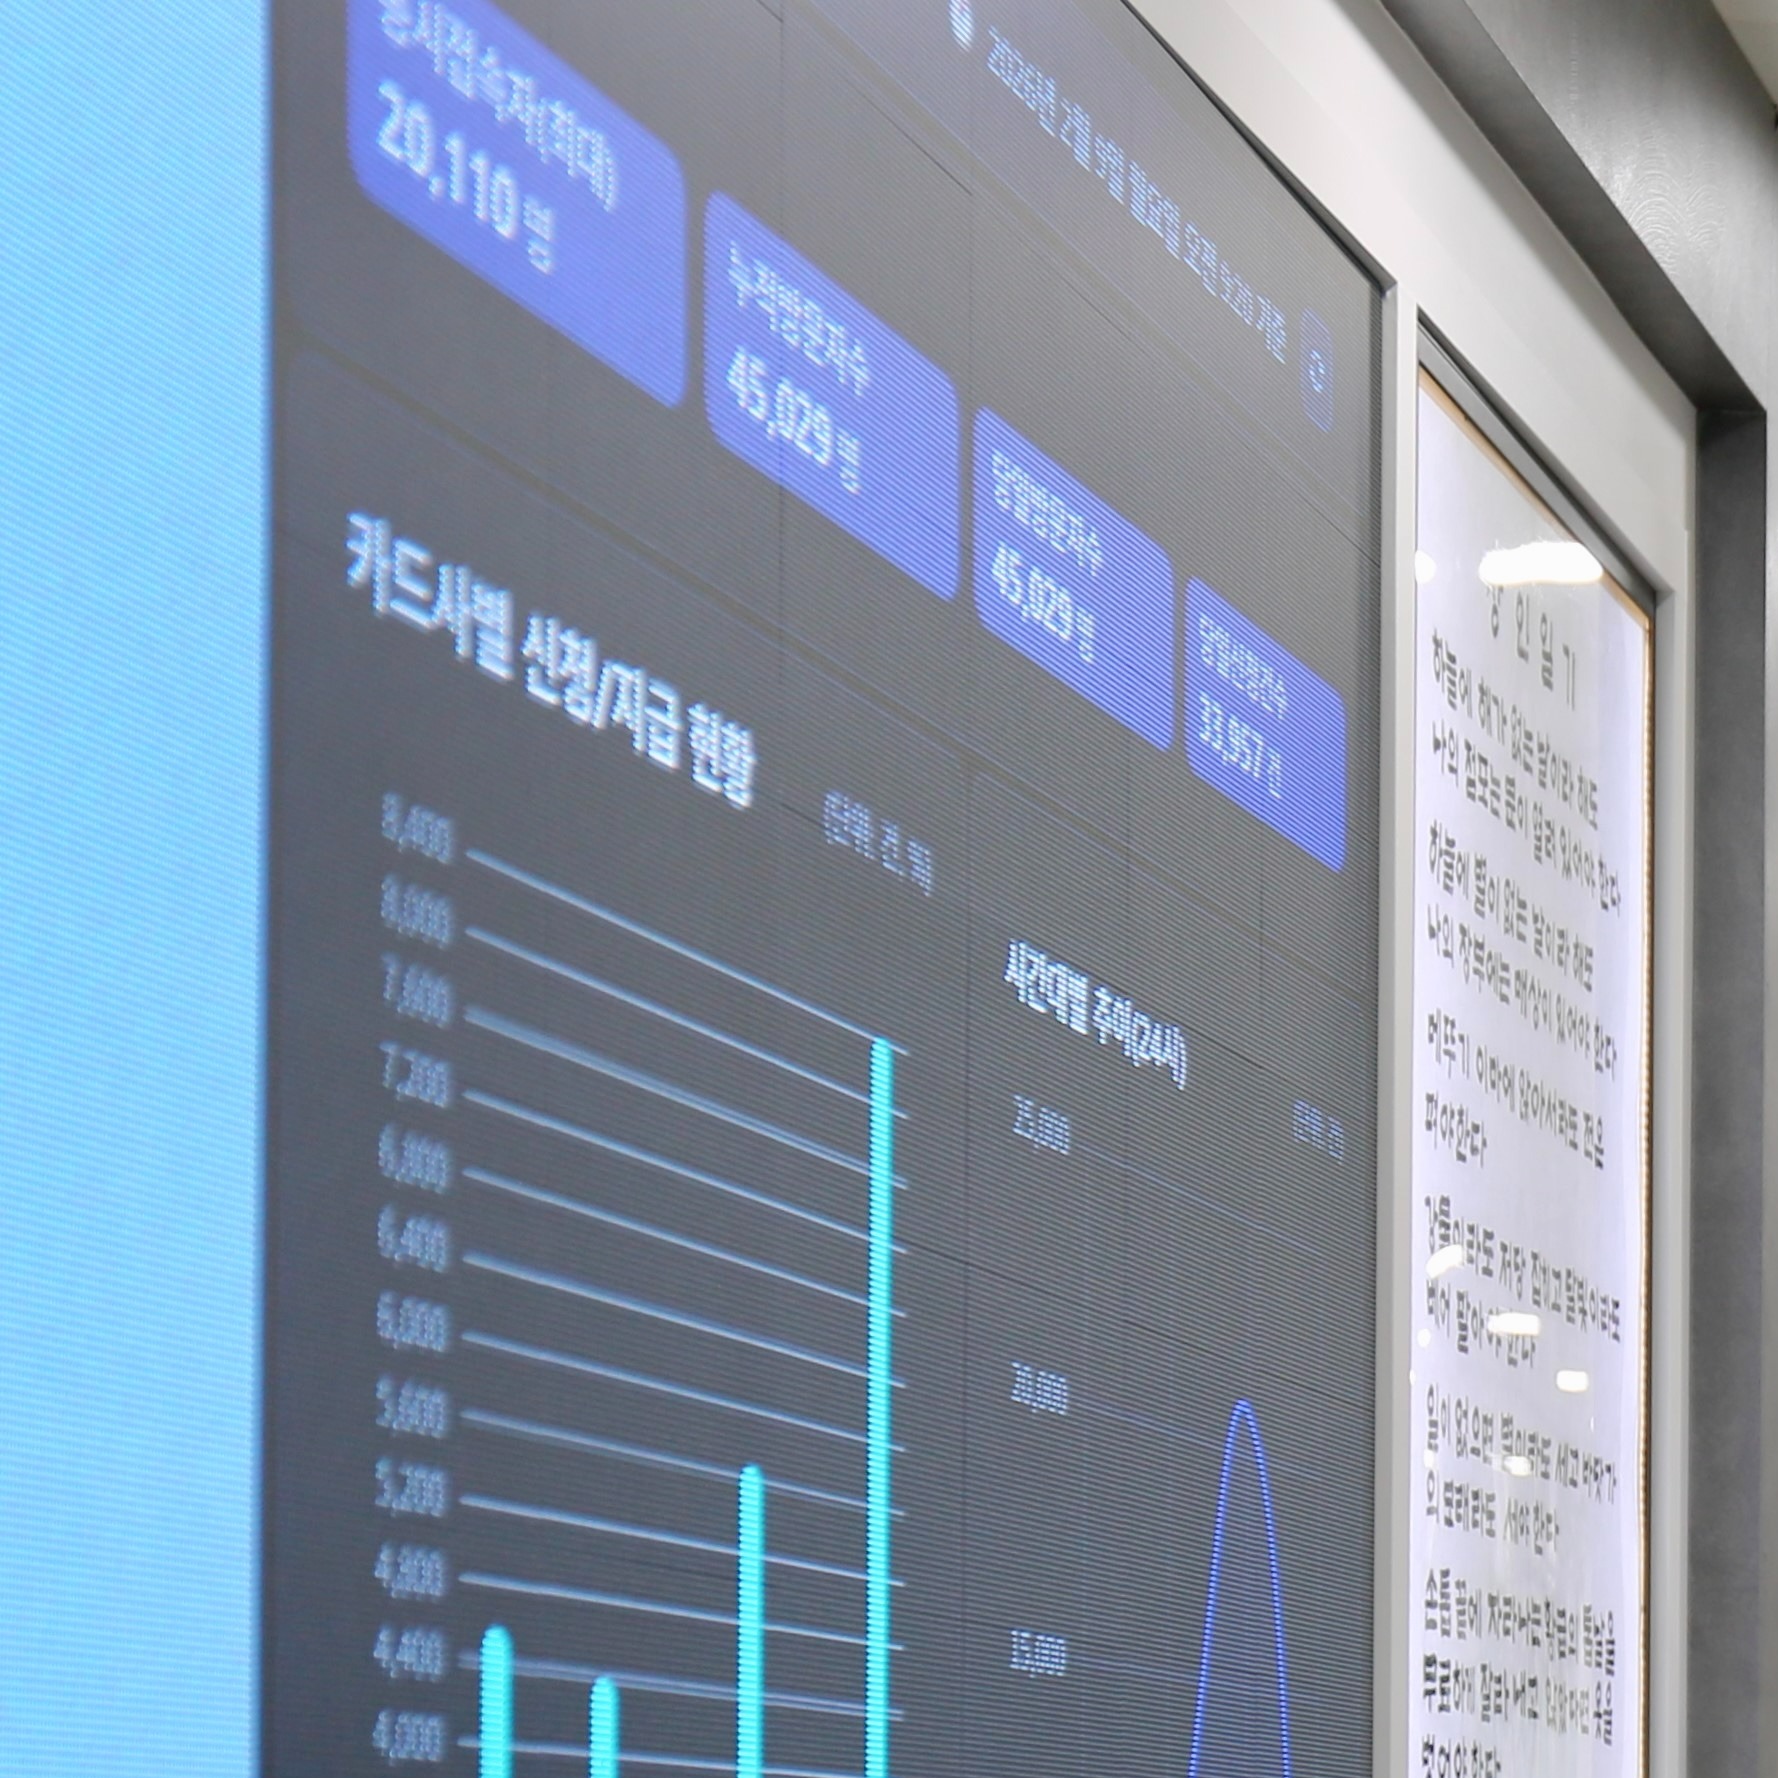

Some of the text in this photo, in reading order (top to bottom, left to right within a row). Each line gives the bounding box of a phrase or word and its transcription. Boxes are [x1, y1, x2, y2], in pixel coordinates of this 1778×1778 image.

[377, 80, 521, 240] 20,110
[726, 346, 834, 467] 45,029
[346, 512, 757, 809] 카드사별 신청/지급 현황
[990, 542, 1075, 643] 45,029
[1197, 690, 1266, 780] 33,957
[1433, 633, 1598, 830] 하늘에 해가 없는 날이라 해도
[1433, 725, 1621, 911] 나의 점포는 문이 열려 있어야 한다
[1430, 822, 1593, 992] 하늘에 별이 없는 날이라 해도
[1003, 941, 1189, 1090] 시간대별 추이(24시)
[1428, 907, 1617, 1073] 나의 장부에는 매상이 있어야 한다
[1428, 1011, 1470, 1078] 메뚜기
[1476, 1048, 1515, 1111] 이마에
[1520, 1070, 1578, 1150] 앉아서라도
